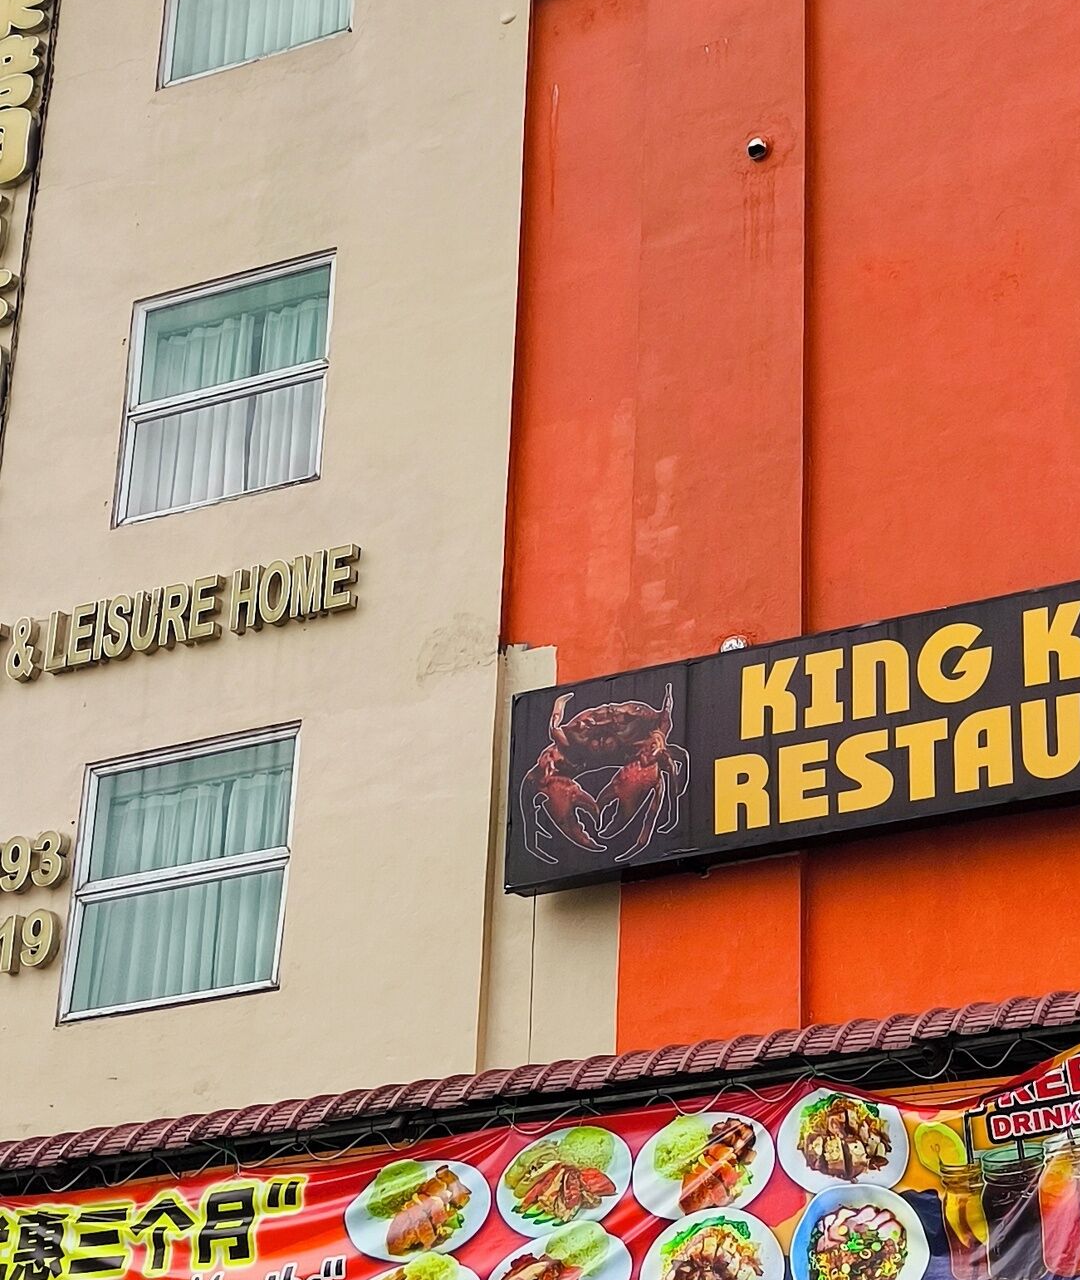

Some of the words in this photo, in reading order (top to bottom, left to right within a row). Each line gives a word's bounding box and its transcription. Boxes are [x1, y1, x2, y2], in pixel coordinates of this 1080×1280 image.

[6, 616, 40, 682] &
[44, 574, 223, 674] LEISURE
[230, 544, 361, 634] HOME
[740, 621, 993, 741] KING
